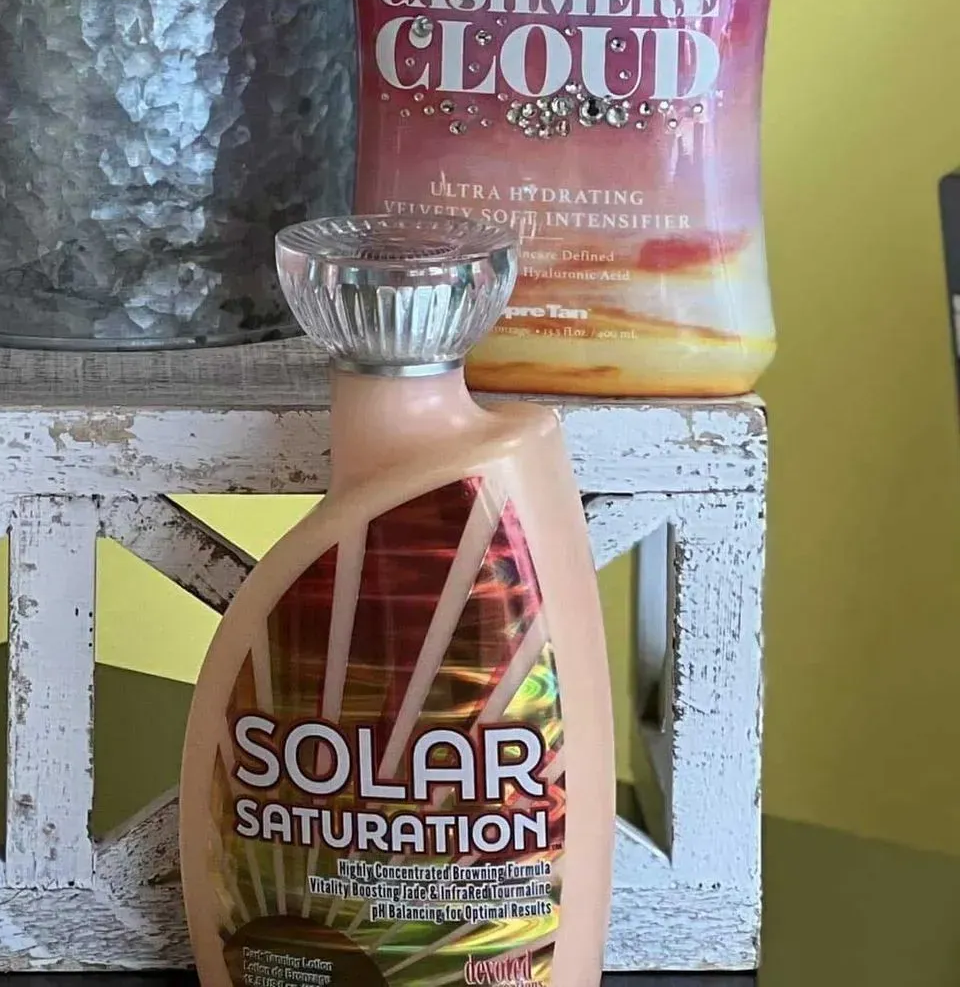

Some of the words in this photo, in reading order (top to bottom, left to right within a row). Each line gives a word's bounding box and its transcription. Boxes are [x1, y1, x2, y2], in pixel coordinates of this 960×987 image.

[375, 16, 721, 100] CLOUD
[431, 181, 500, 200] ULTRA
[509, 186, 644, 205] HYDRATING
[482, 209, 537, 226] SOFT
[546, 212, 690, 230] INTENSIFIER
[562, 250, 614, 262] Defined
[523, 266, 597, 281] Hyaluronic
[599, 270, 631, 281] Acid
[502, 305, 545, 319] pre
[546, 304, 588, 320] Tan
[234, 715, 545, 801] SOLAR
[235, 798, 548, 854] SATURATION
[339, 861, 372, 879] Highly
[375, 863, 449, 880] Concentrated
[452, 863, 505, 882] Browning
[508, 861, 551, 877] Formula
[310, 878, 349, 897] Vitality
[352, 883, 399, 901] Boosting
[402, 884, 426, 900] Jade
[429, 885, 437, 899] &
[441, 883, 488, 900] InfraRed
[490, 882, 551, 898] Tourmaline
[371, 905, 384, 921] pH
[390, 904, 441, 923] Balancing
[445, 906, 463, 919] for
[465, 904, 508, 922] Optimal
[511, 901, 551, 917] Results
[302, 957, 333, 971] Lotion
[464, 949, 533, 985] devoted
